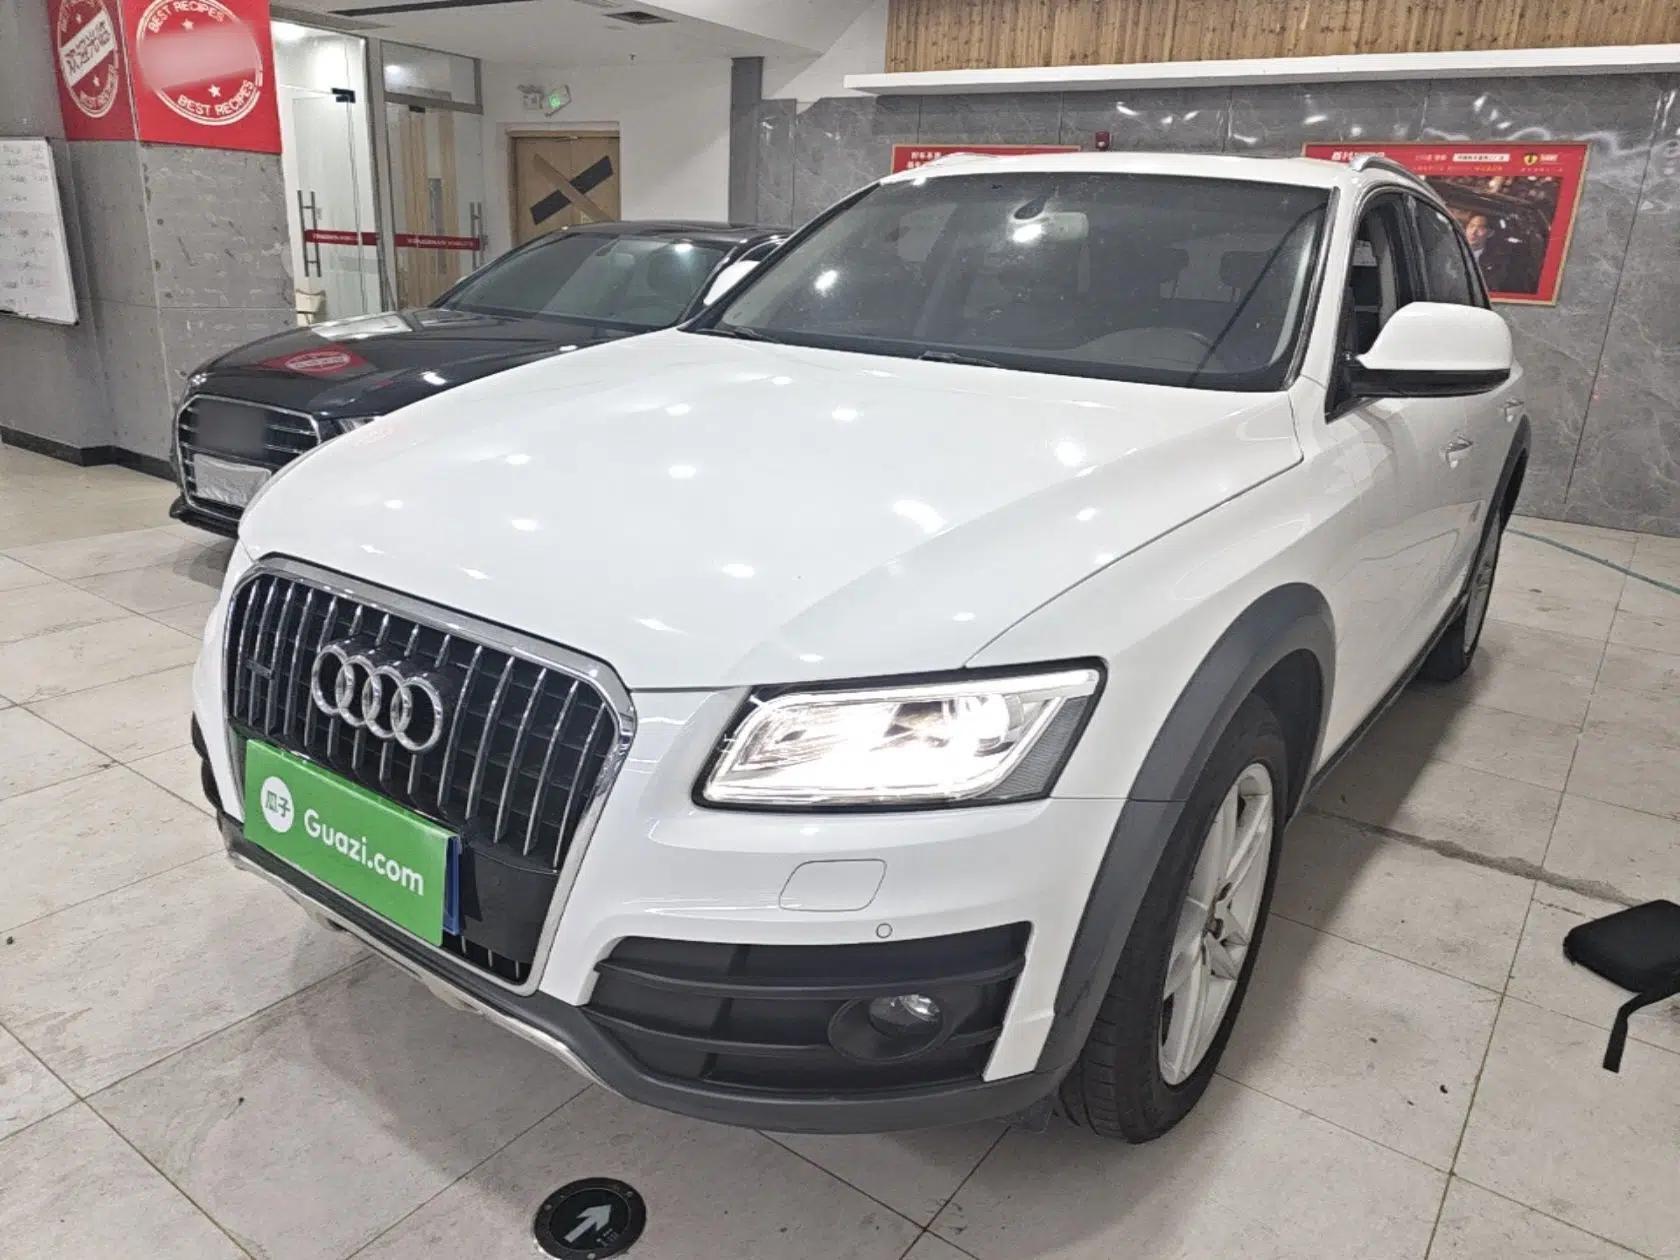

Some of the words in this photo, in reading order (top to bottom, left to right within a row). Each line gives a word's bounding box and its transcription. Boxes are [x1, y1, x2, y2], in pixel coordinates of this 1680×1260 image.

[148, 5, 172, 33] BEST
[173, 0, 225, 22] RECIPES
[177, 94, 211, 116] BEST
[214, 79, 254, 116] RECIPES
[265, 790, 291, 817] 瓜子
[304, 809, 424, 895] Guazi.com
